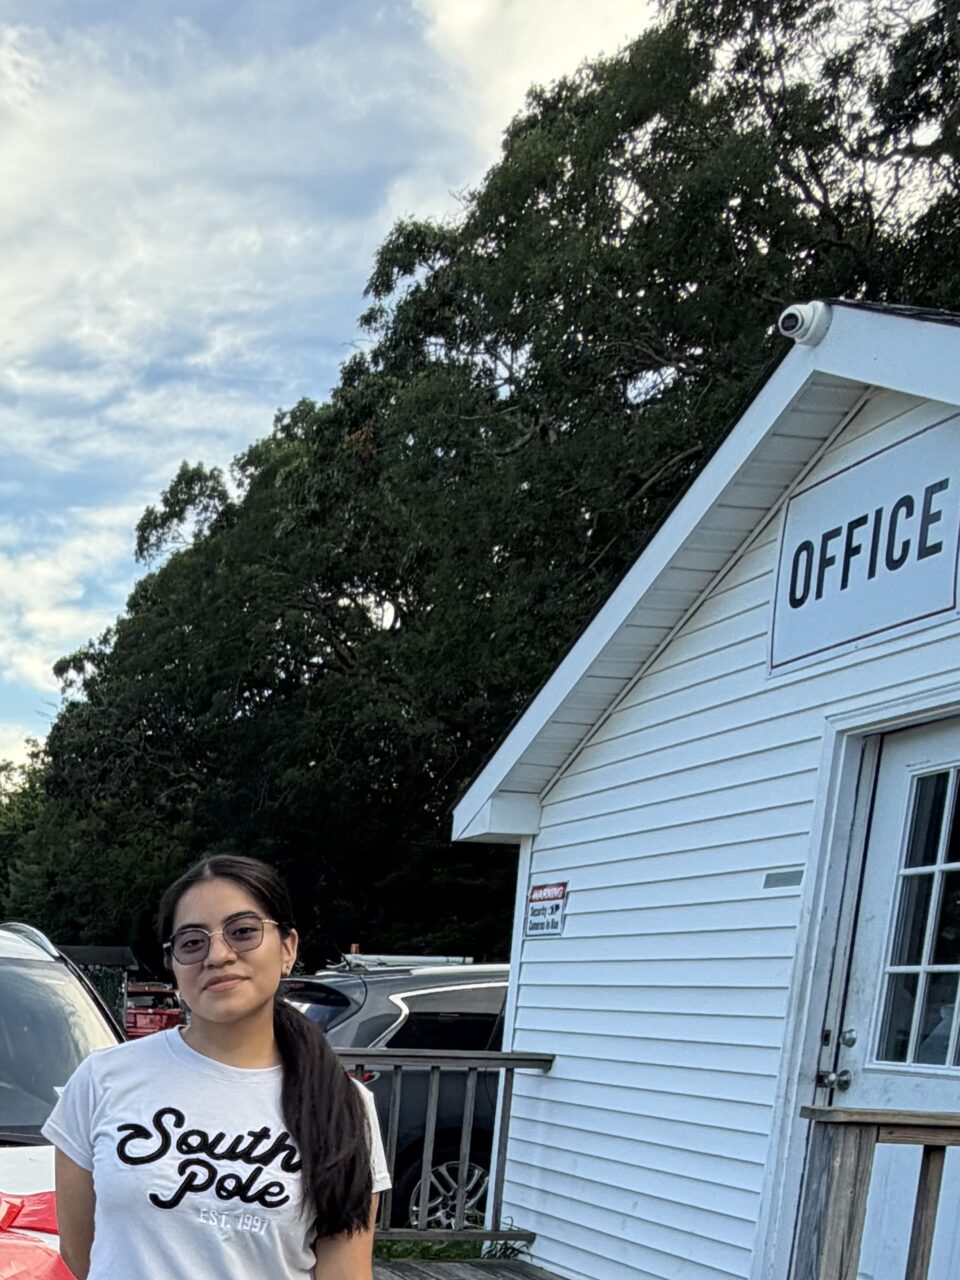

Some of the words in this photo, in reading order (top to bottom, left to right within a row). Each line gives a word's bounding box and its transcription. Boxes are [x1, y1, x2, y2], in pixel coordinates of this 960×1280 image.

[788, 477, 950, 609] OFFICE
[532, 886, 563, 899] WARNING
[116, 1106, 303, 1173] South
[149, 1158, 290, 1210] Pole
[199, 1208, 231, 1229] EST.
